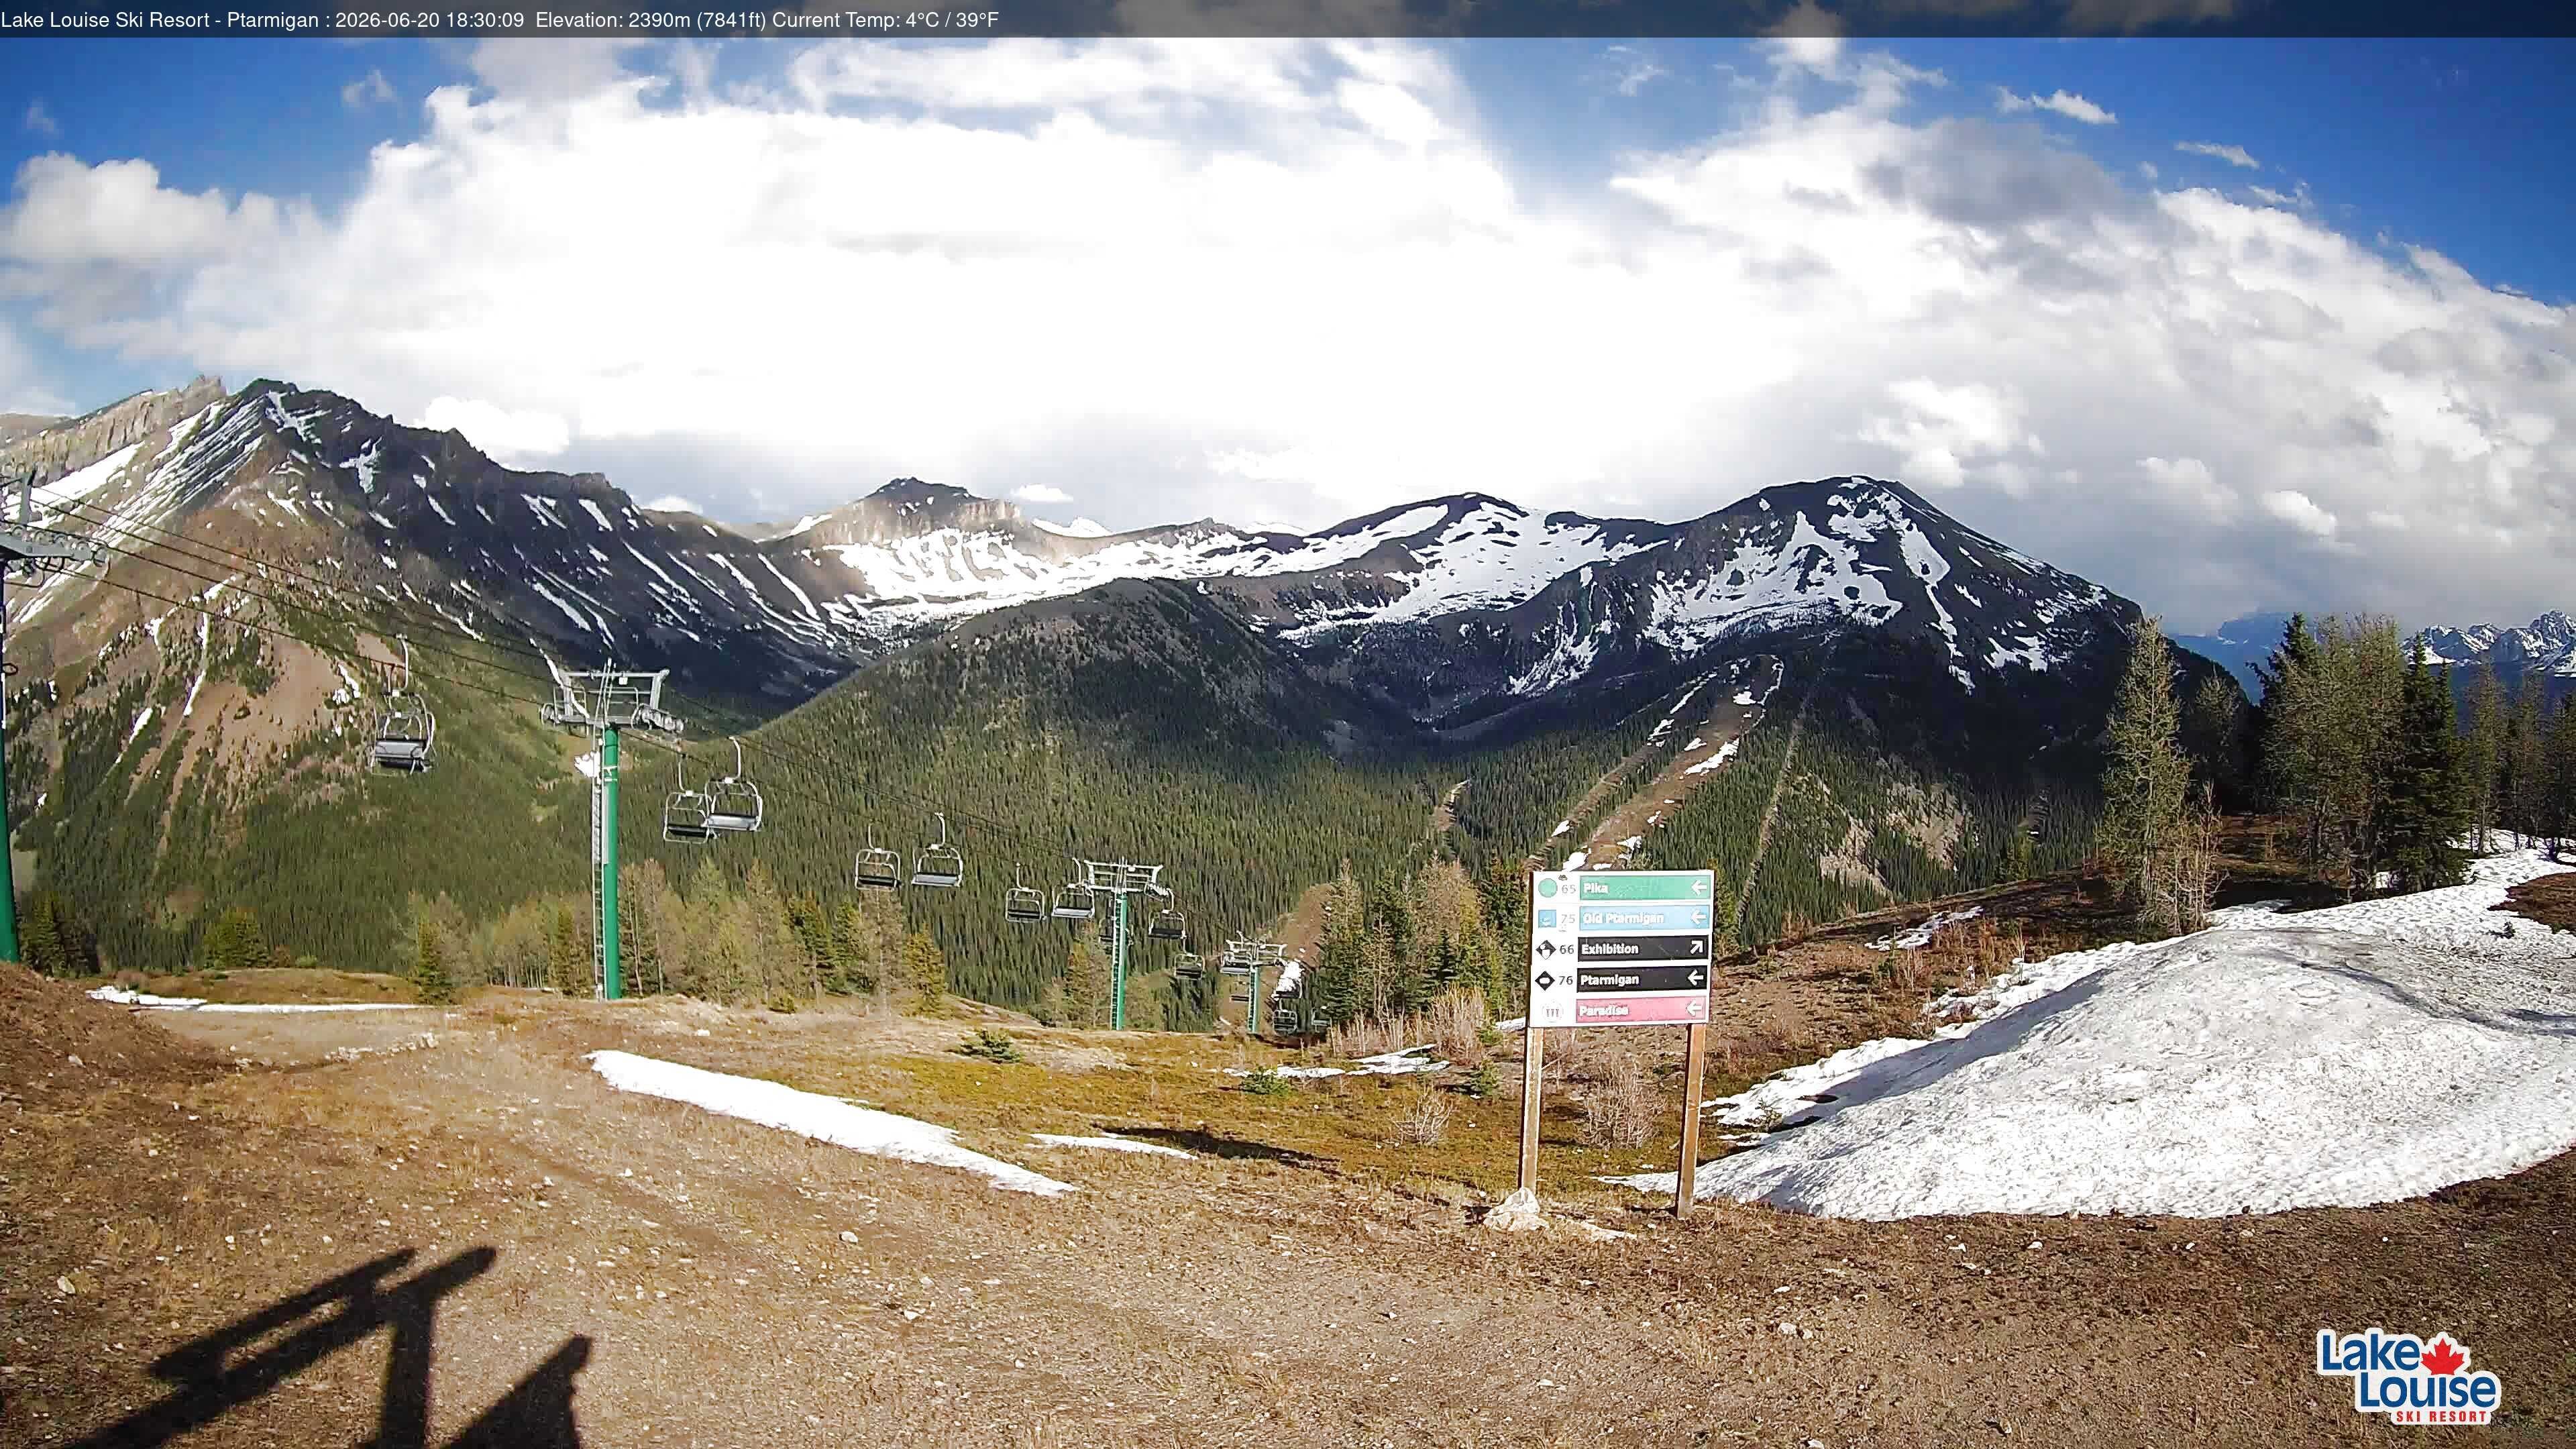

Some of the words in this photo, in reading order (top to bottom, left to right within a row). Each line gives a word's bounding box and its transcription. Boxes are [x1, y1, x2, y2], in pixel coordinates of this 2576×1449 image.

[1561, 885, 1576, 894] 65
[1583, 883, 1609, 894] Pika
[1561, 914, 1576, 924] 75
[1560, 945, 1574, 954] 66
[1581, 943, 1639, 955] Exhibition
[1558, 975, 1573, 985] 76
[1580, 974, 1640, 988] Ptarmigan
